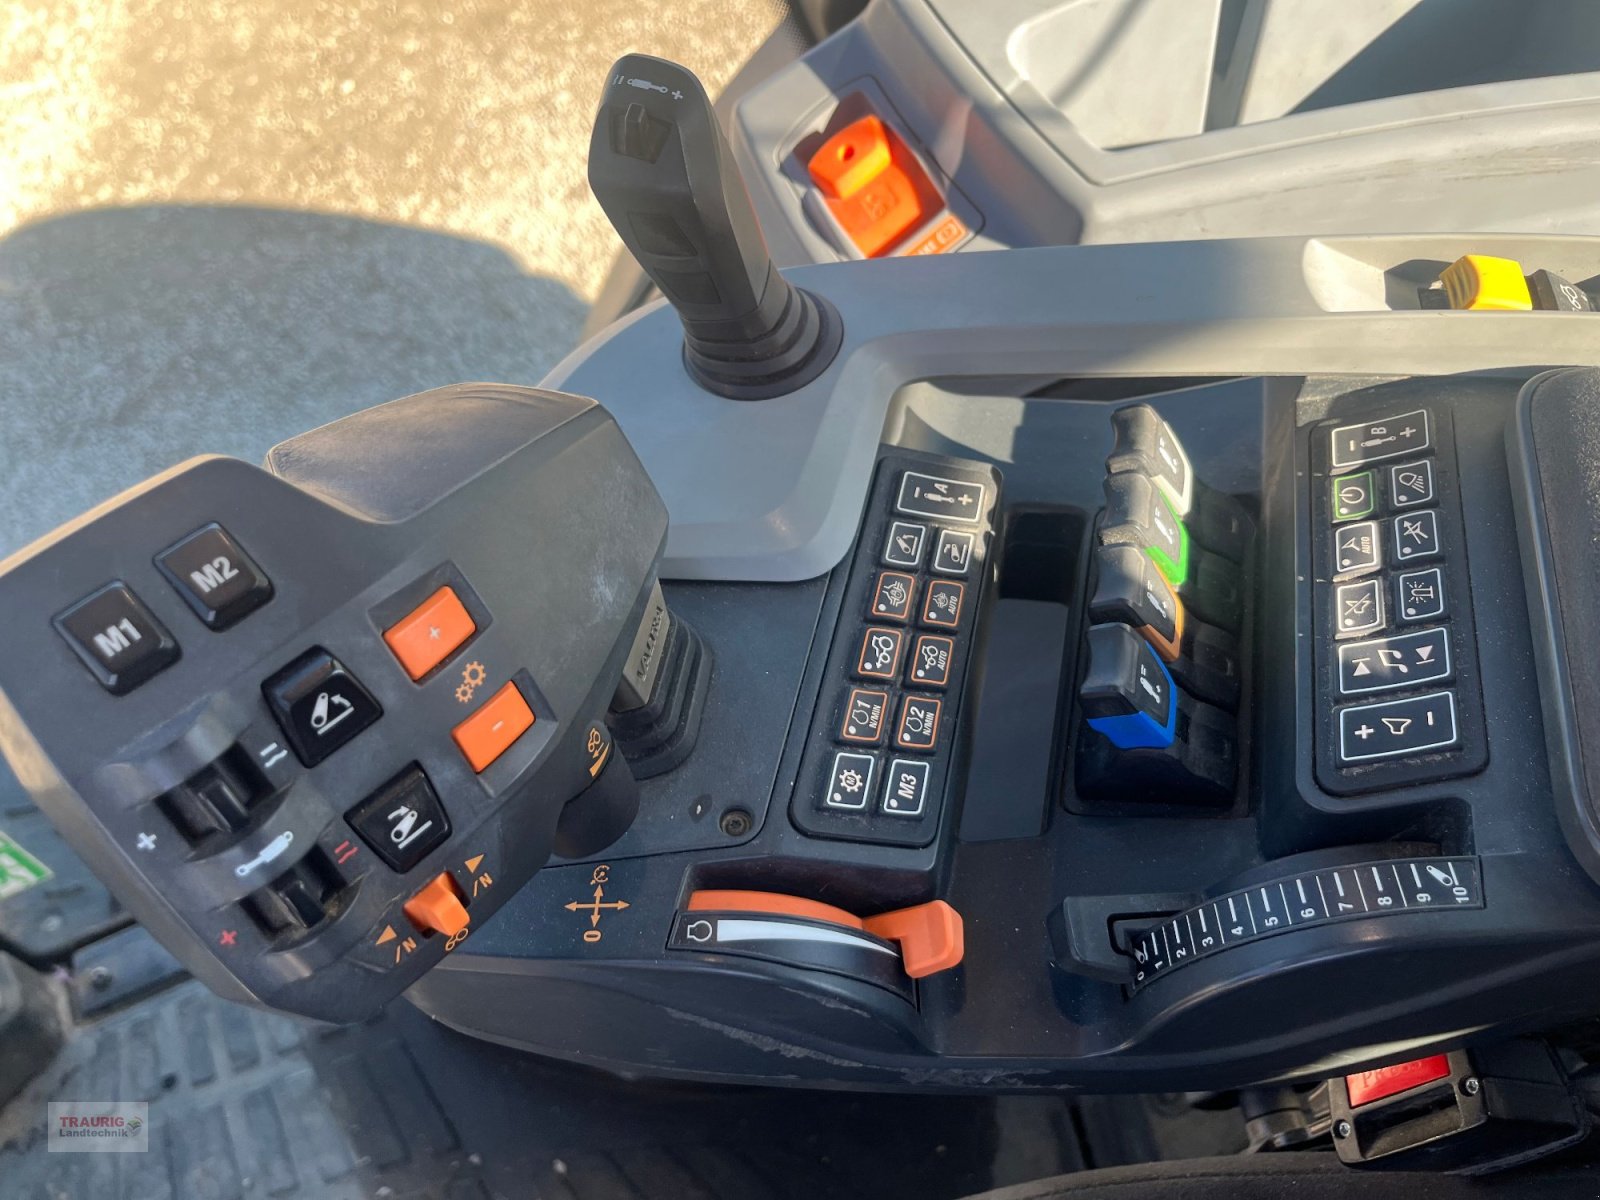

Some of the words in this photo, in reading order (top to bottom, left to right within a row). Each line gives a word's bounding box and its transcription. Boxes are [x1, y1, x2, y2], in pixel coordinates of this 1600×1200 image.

[1370, 426, 1387, 435] B
[934, 483, 949, 494] A
[1360, 536, 1371, 554] AUTO
[189, 556, 240, 593] M2
[947, 595, 958, 615] AUTO
[94, 617, 142, 658] M1
[936, 650, 948, 671] AUTO
[856, 699, 871, 709] 1
[910, 706, 925, 718] 2
[868, 704, 882, 729] N/MIN
[922, 712, 935, 736] N/MIN
[898, 773, 917, 800] M3
[1154, 960, 1163, 970] 1
[1175, 947, 1187, 958] 2
[1201, 936, 1214, 947] 3
[1231, 925, 1244, 936] 4
[1264, 916, 1279, 927] 5
[1300, 907, 1316, 918] 6
[1338, 901, 1354, 911] 7
[1377, 896, 1392, 906] 8
[1416, 892, 1431, 903] 9
[1452, 886, 1470, 903] 10
